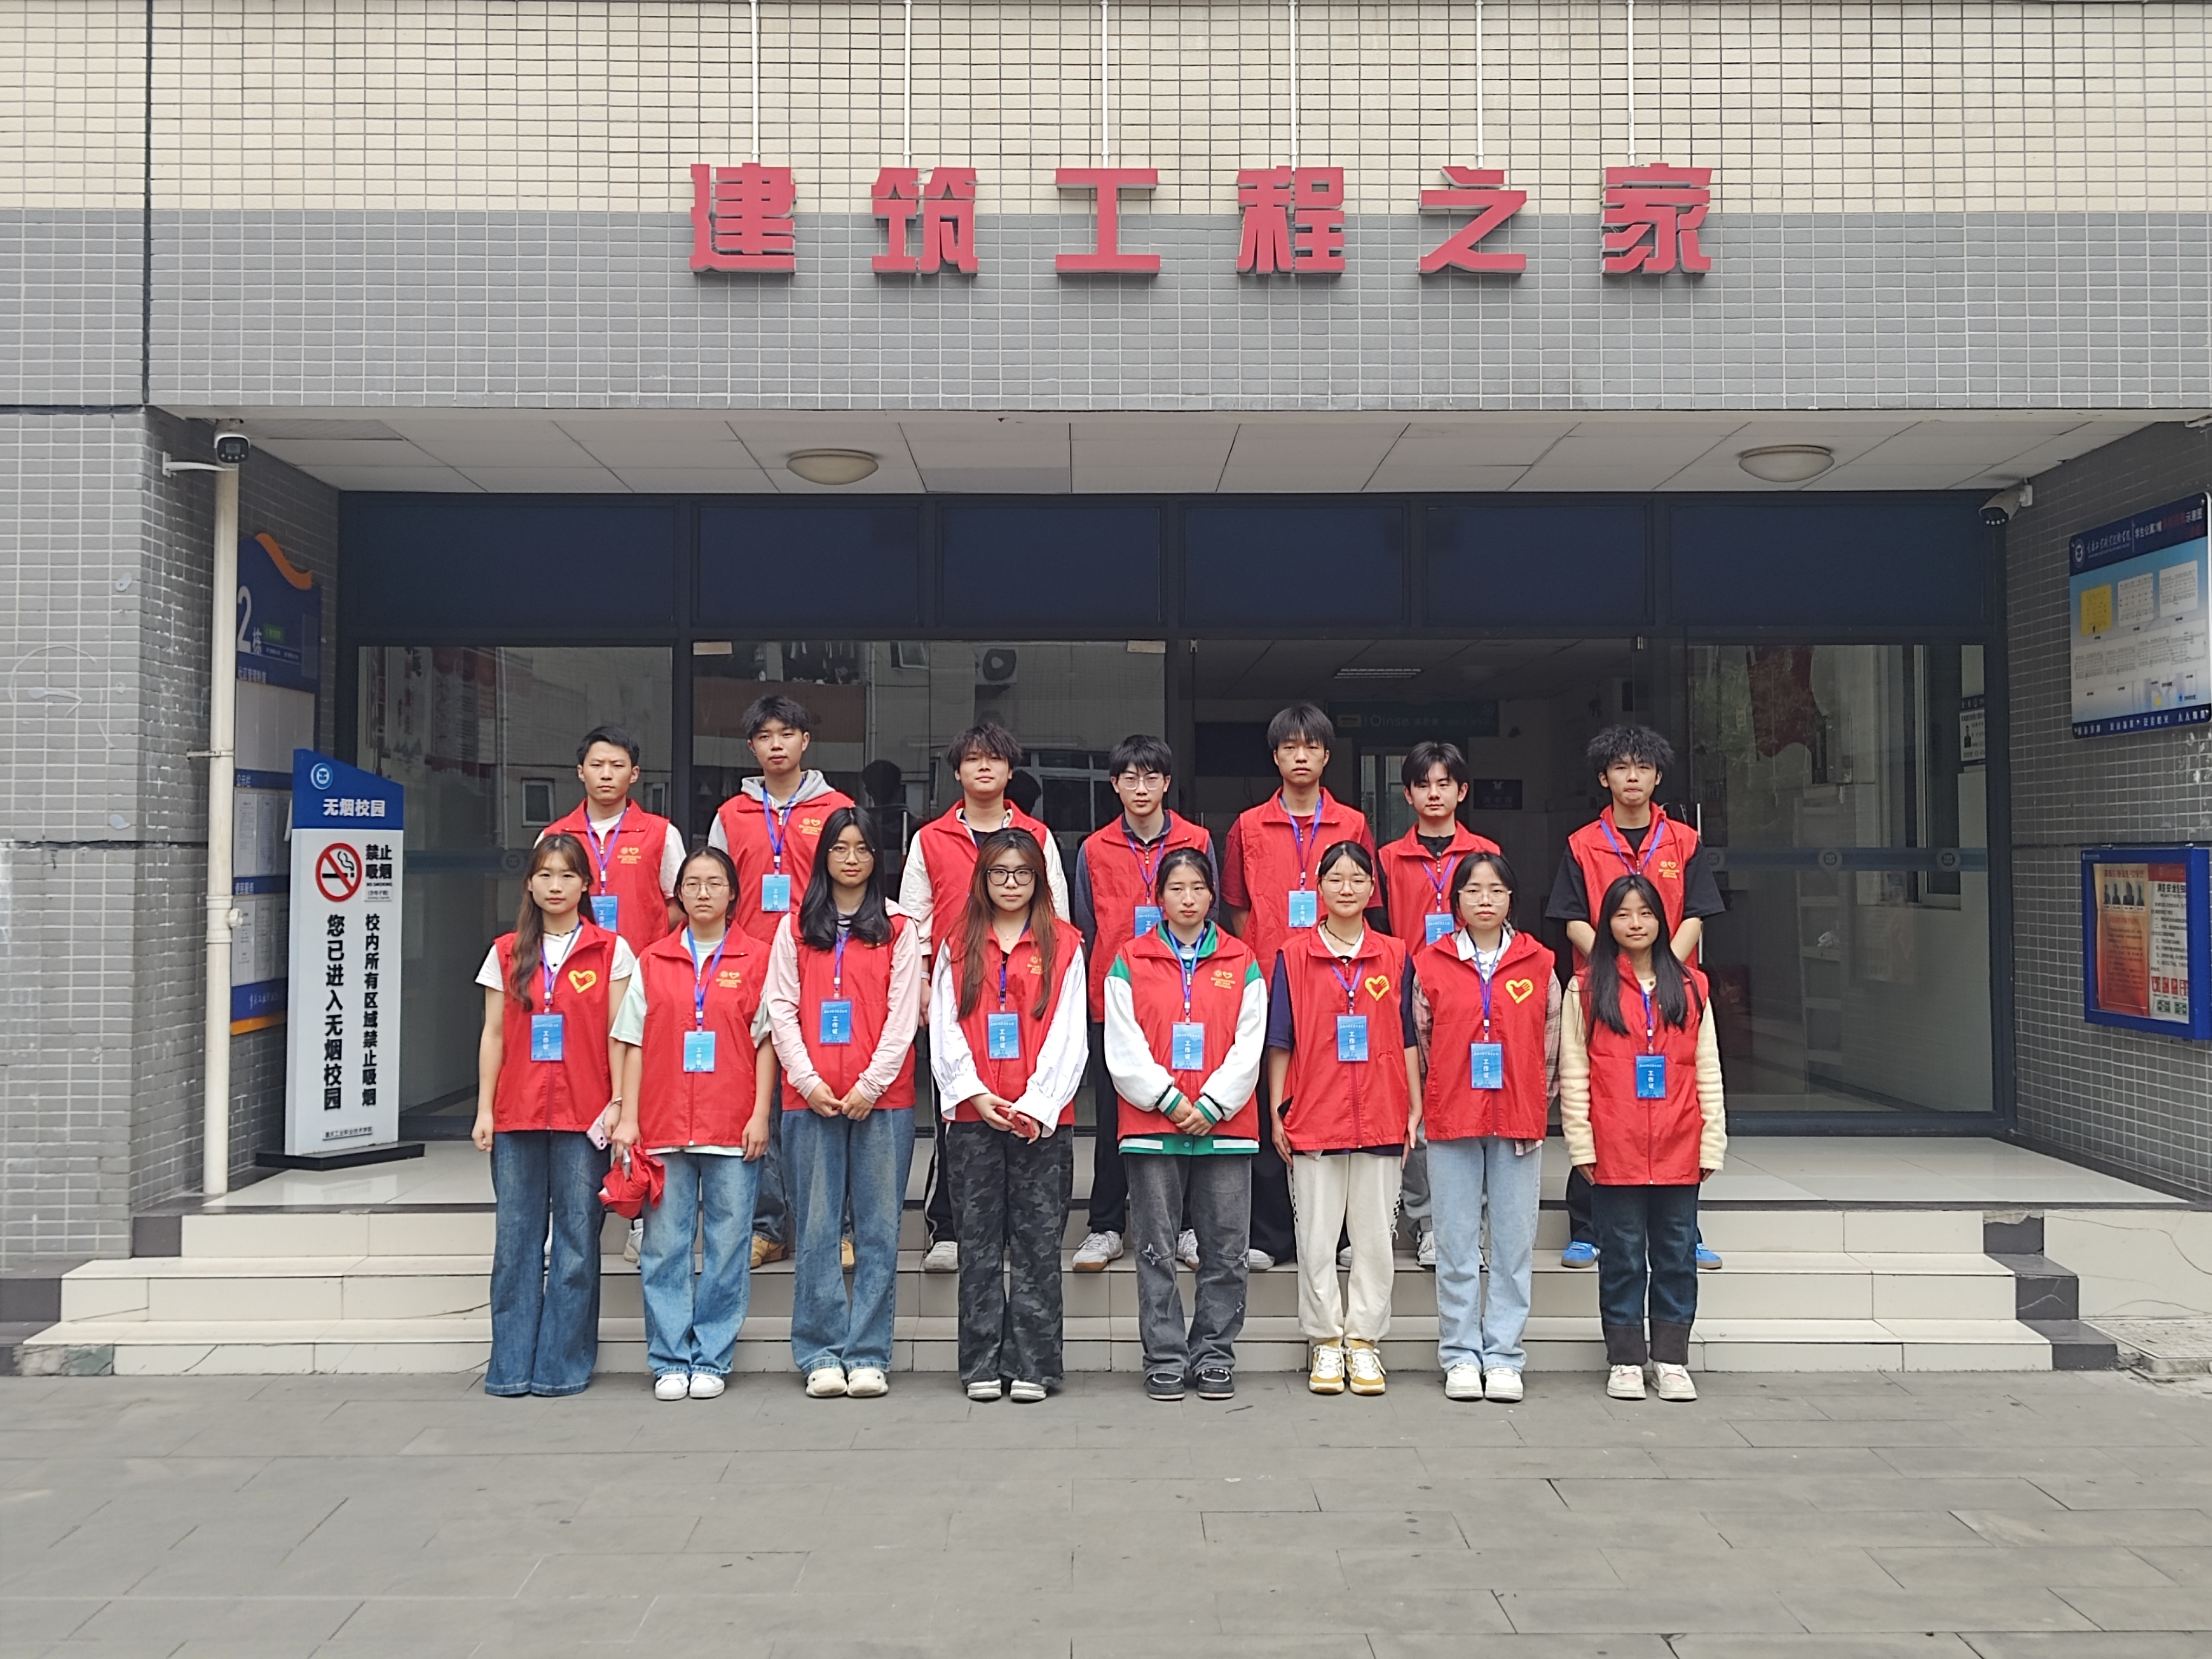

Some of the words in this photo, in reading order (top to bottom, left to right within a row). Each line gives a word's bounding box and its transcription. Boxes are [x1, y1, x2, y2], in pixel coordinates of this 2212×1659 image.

[690, 162, 1712, 273] 建筑工程之家
[323, 799, 385, 817] 无烟校园
[365, 844, 392, 860] 禁止
[365, 864, 392, 879] 吸烟
[324, 914, 345, 1110] 您已进入无烟校园
[362, 914, 380, 1106] 校内所有区域禁止吸烟
